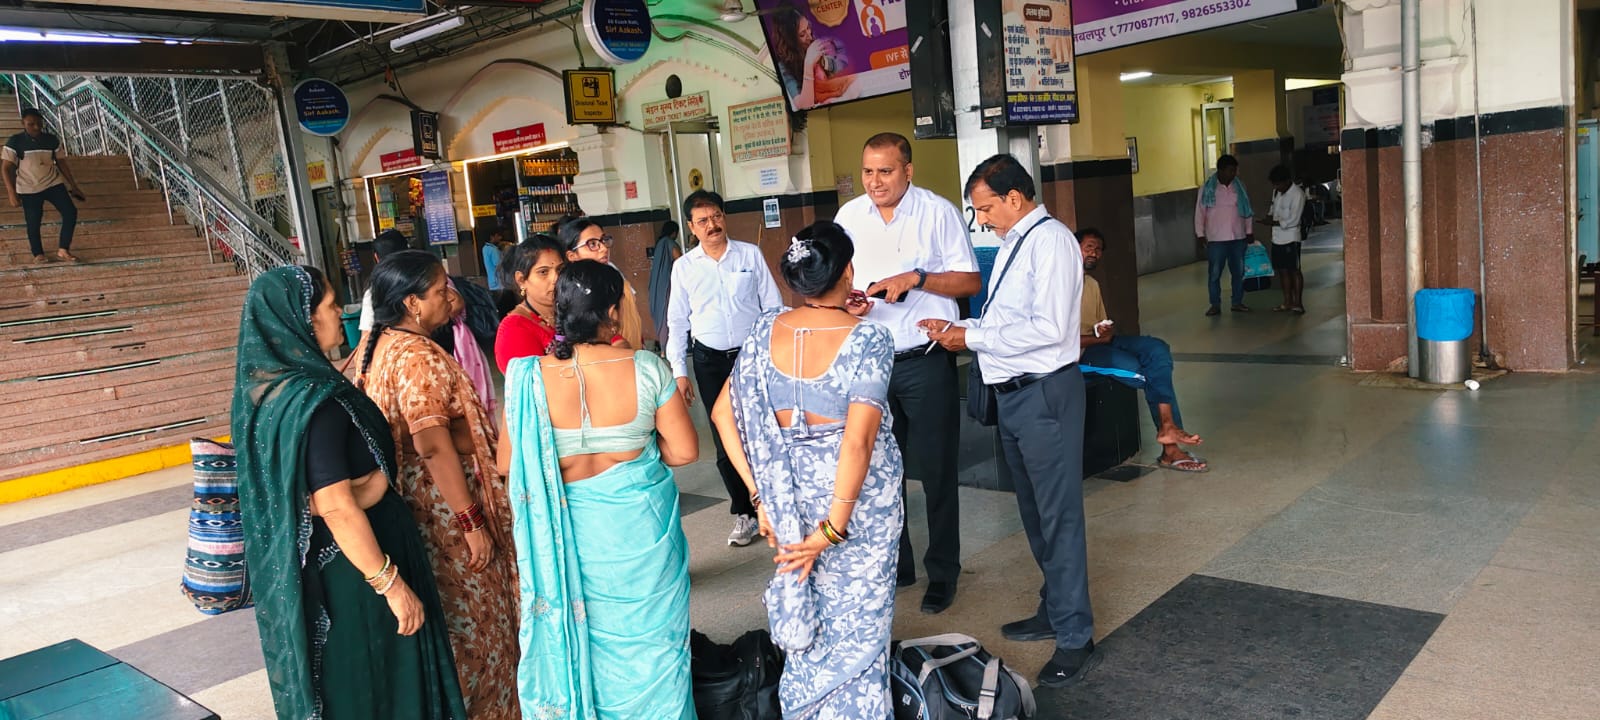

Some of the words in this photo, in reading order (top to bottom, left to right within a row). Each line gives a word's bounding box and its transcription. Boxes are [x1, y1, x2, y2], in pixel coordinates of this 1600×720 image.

[816, 0, 844, 13] CENTER
[1117, 13, 1179, 35] 7770877117,
[1181, 0, 1251, 20] 9826553302
[885, 51, 899, 63] IVF
[667, 112, 681, 121] TICKET
